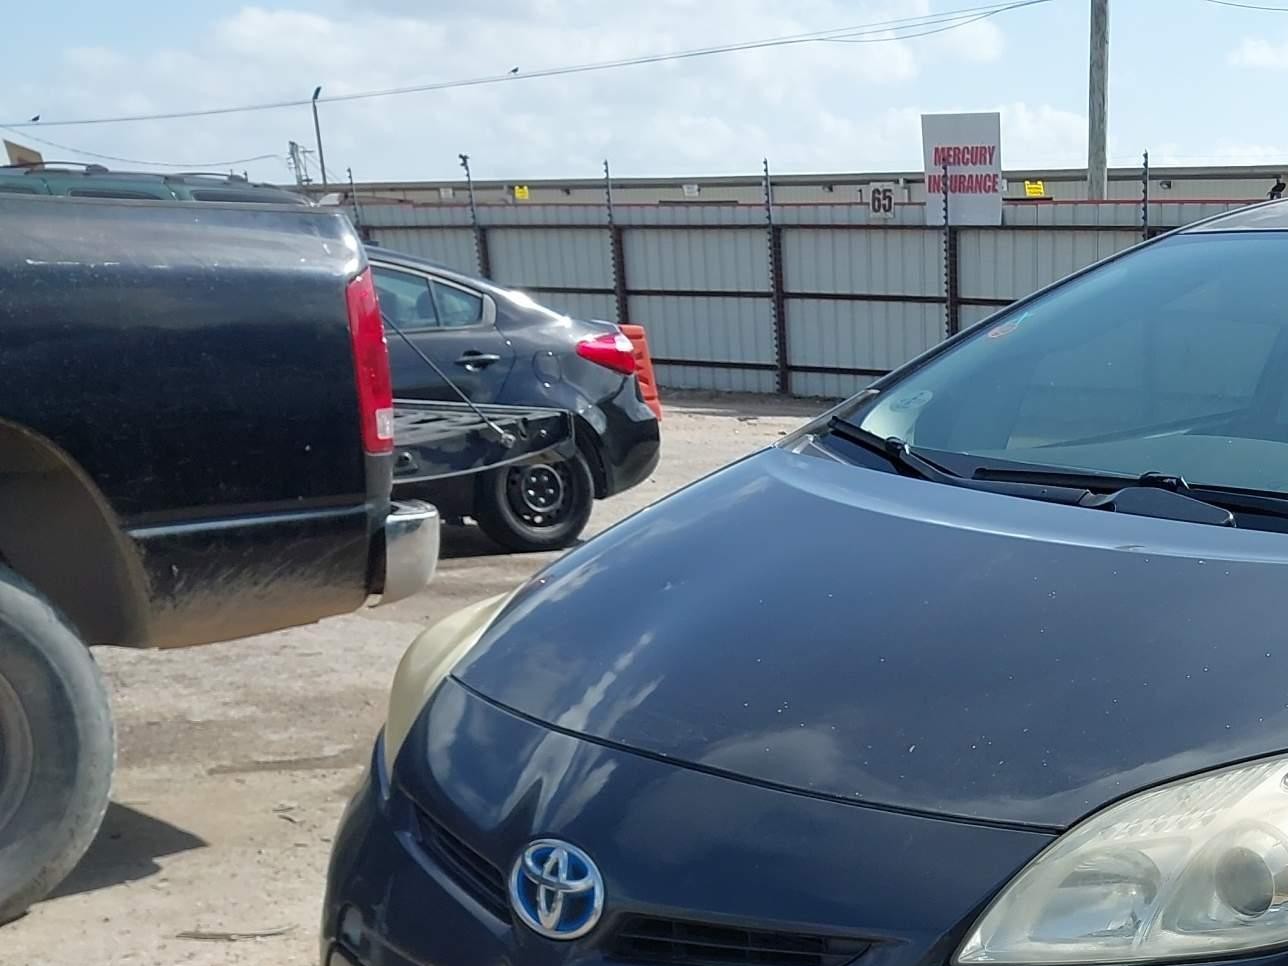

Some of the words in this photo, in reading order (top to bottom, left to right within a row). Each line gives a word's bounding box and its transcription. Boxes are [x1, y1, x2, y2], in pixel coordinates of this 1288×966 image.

[933, 146, 996, 167] MERCURY
[928, 173, 999, 195] INSURANCE
[871, 187, 893, 213] 65
